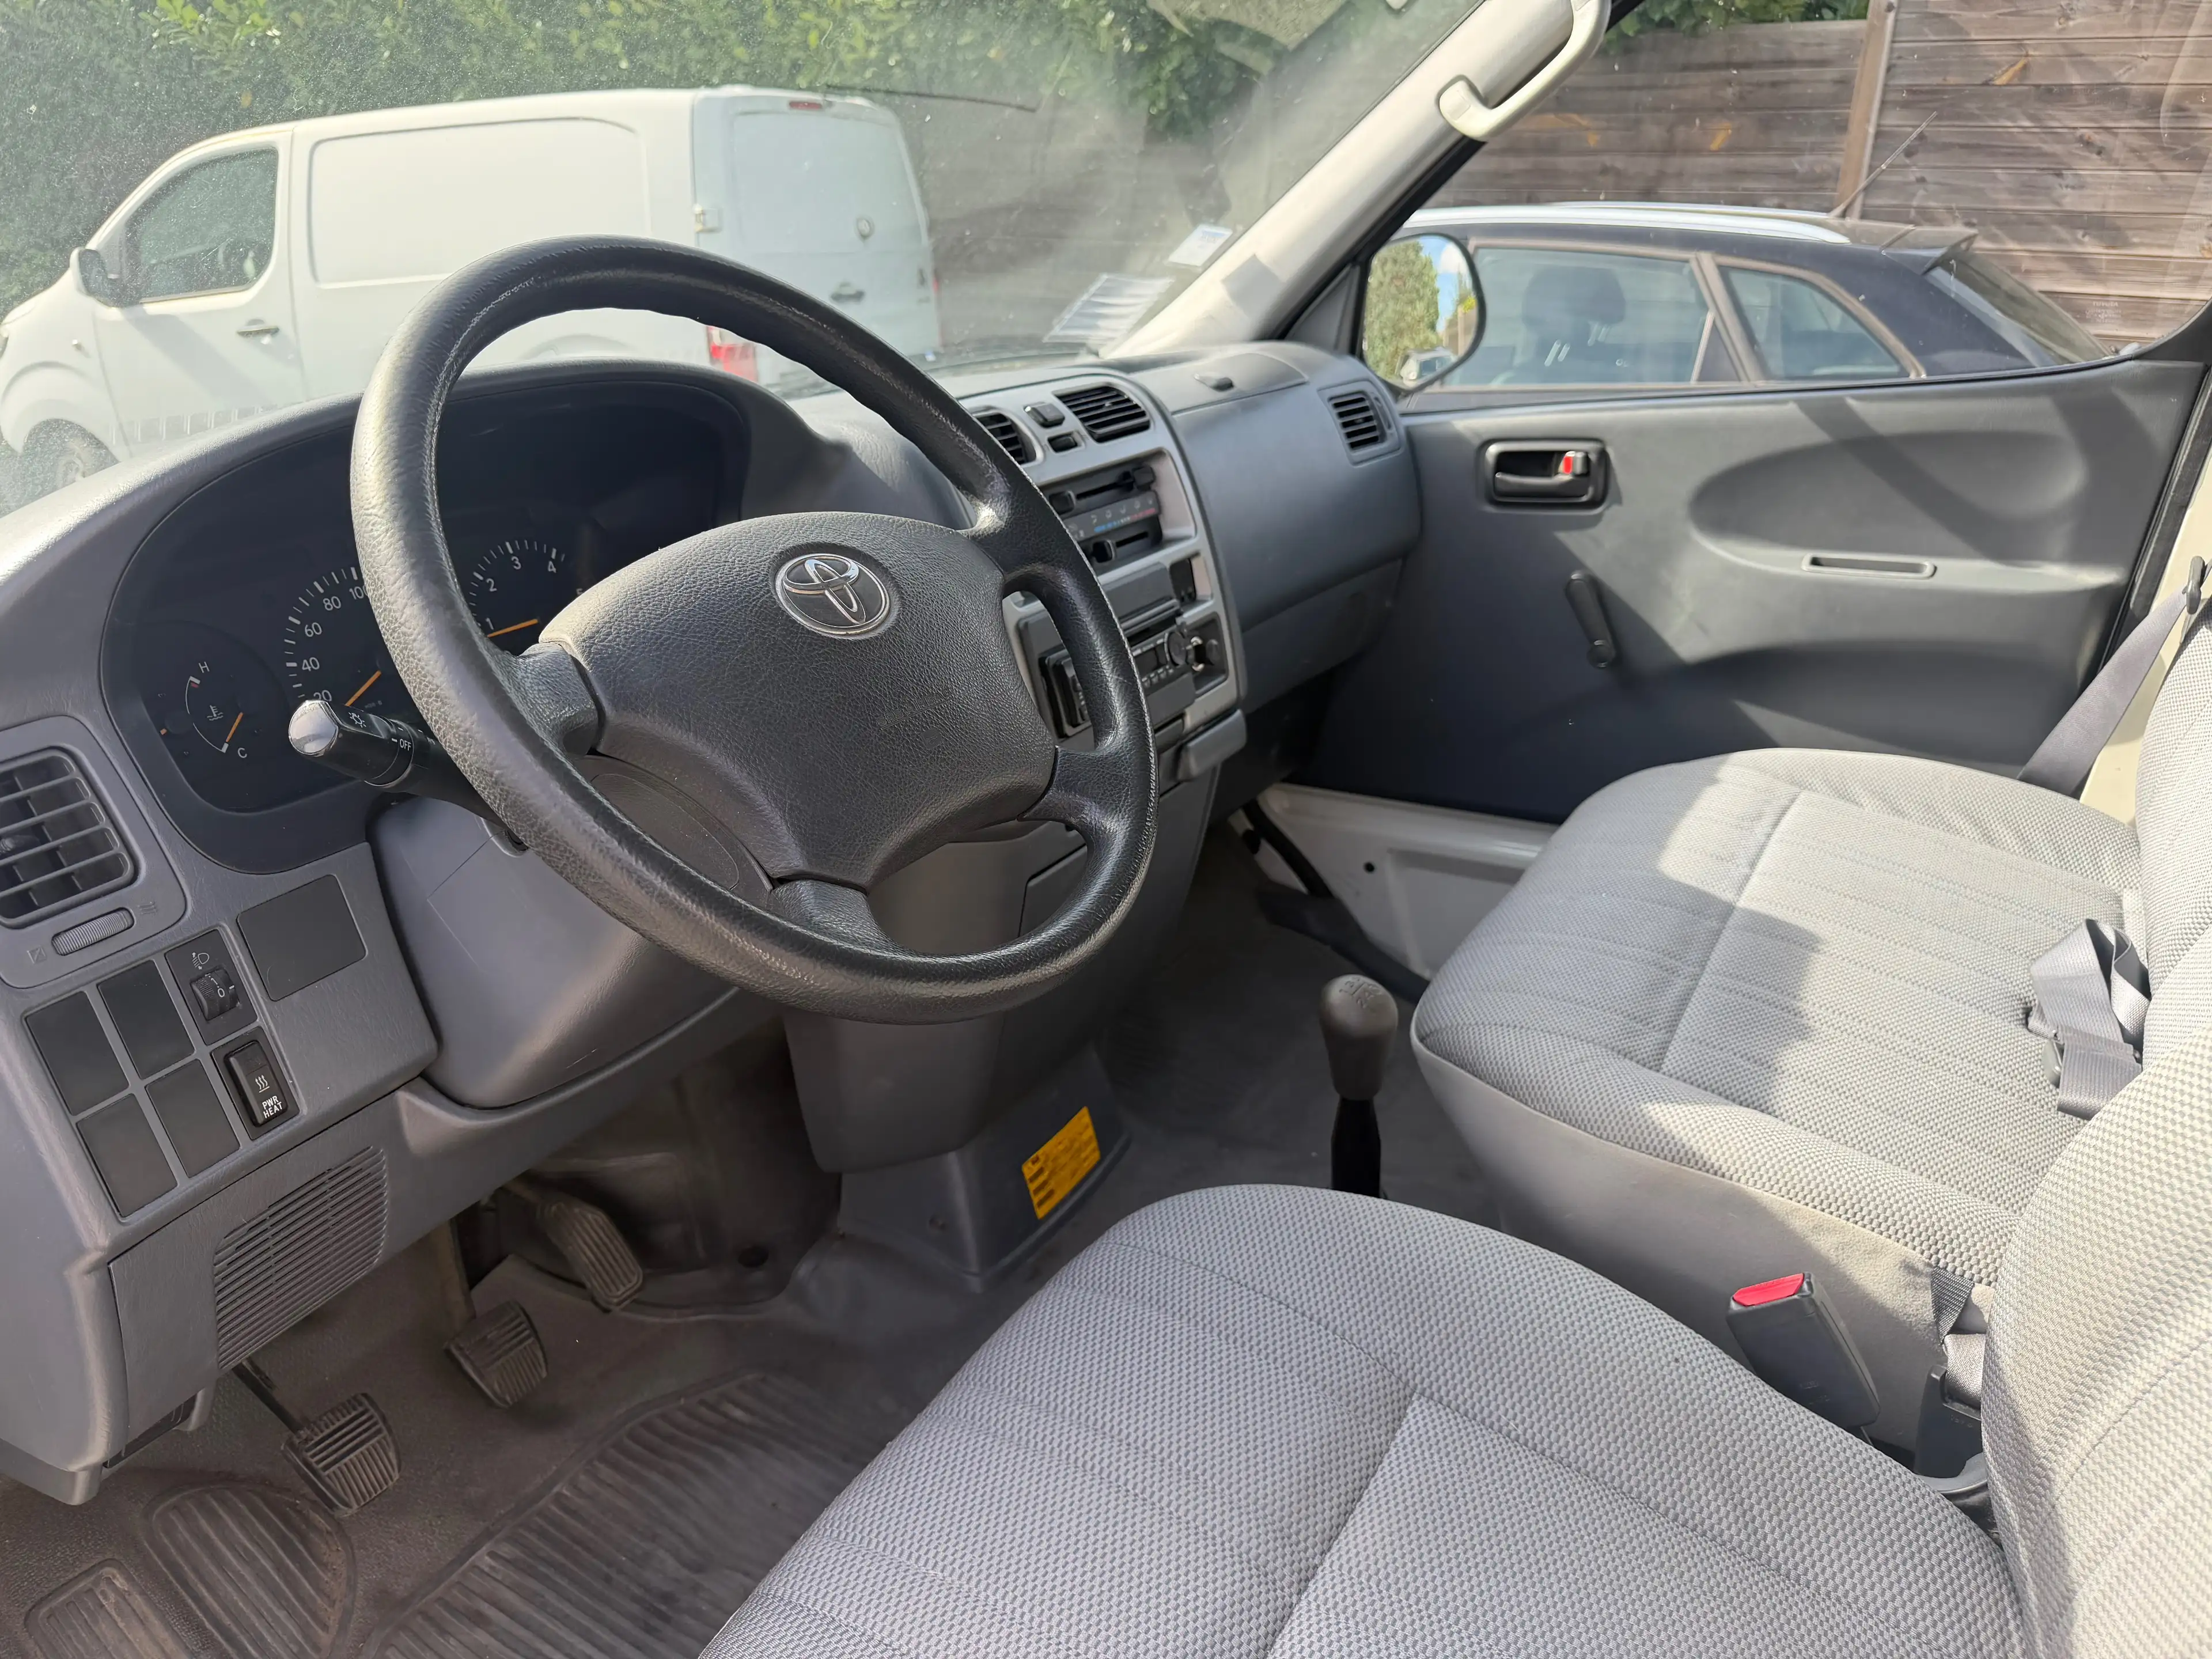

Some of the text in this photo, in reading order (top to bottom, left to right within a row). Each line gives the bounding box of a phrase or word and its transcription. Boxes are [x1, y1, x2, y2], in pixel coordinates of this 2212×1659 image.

[511, 556, 522, 570] 3
[548, 560, 556, 573] 4
[486, 578, 497, 592] 2
[323, 596, 341, 611] 80
[305, 622, 322, 637] 60
[485, 618, 494, 630] 1
[198, 661, 210, 673] H
[302, 657, 320, 672] 40
[399, 738, 411, 751] OFF
[237, 748, 247, 758] C
[217, 988, 225, 998] 0
[262, 1095, 279, 1110] PWR
[263, 1101, 283, 1119] HEAT
